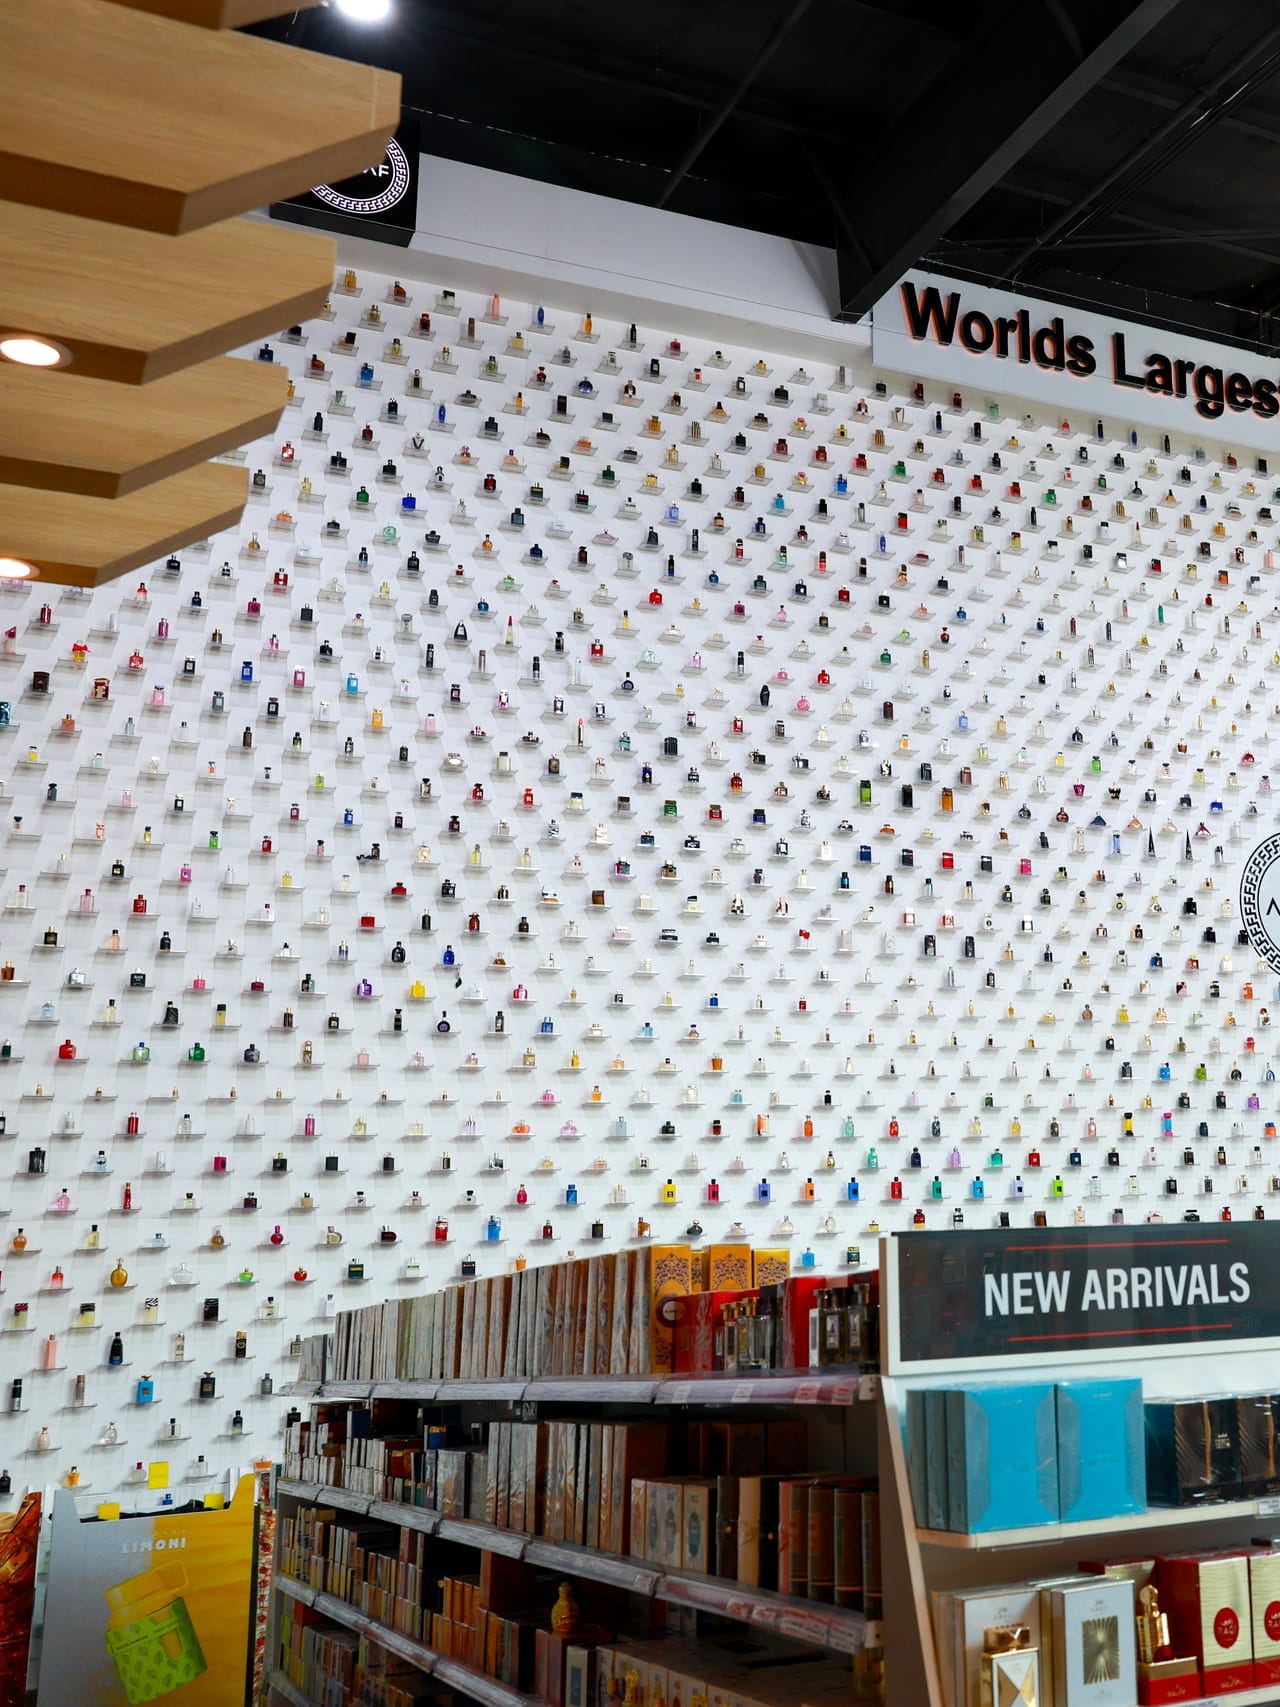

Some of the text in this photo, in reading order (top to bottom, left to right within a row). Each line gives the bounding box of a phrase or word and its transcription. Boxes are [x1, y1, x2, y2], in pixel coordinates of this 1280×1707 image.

[901, 281, 1098, 378] Worlds
[984, 1262, 1250, 1317] NEW ARRIVALS
[121, 1537, 187, 1554] LIMONI
